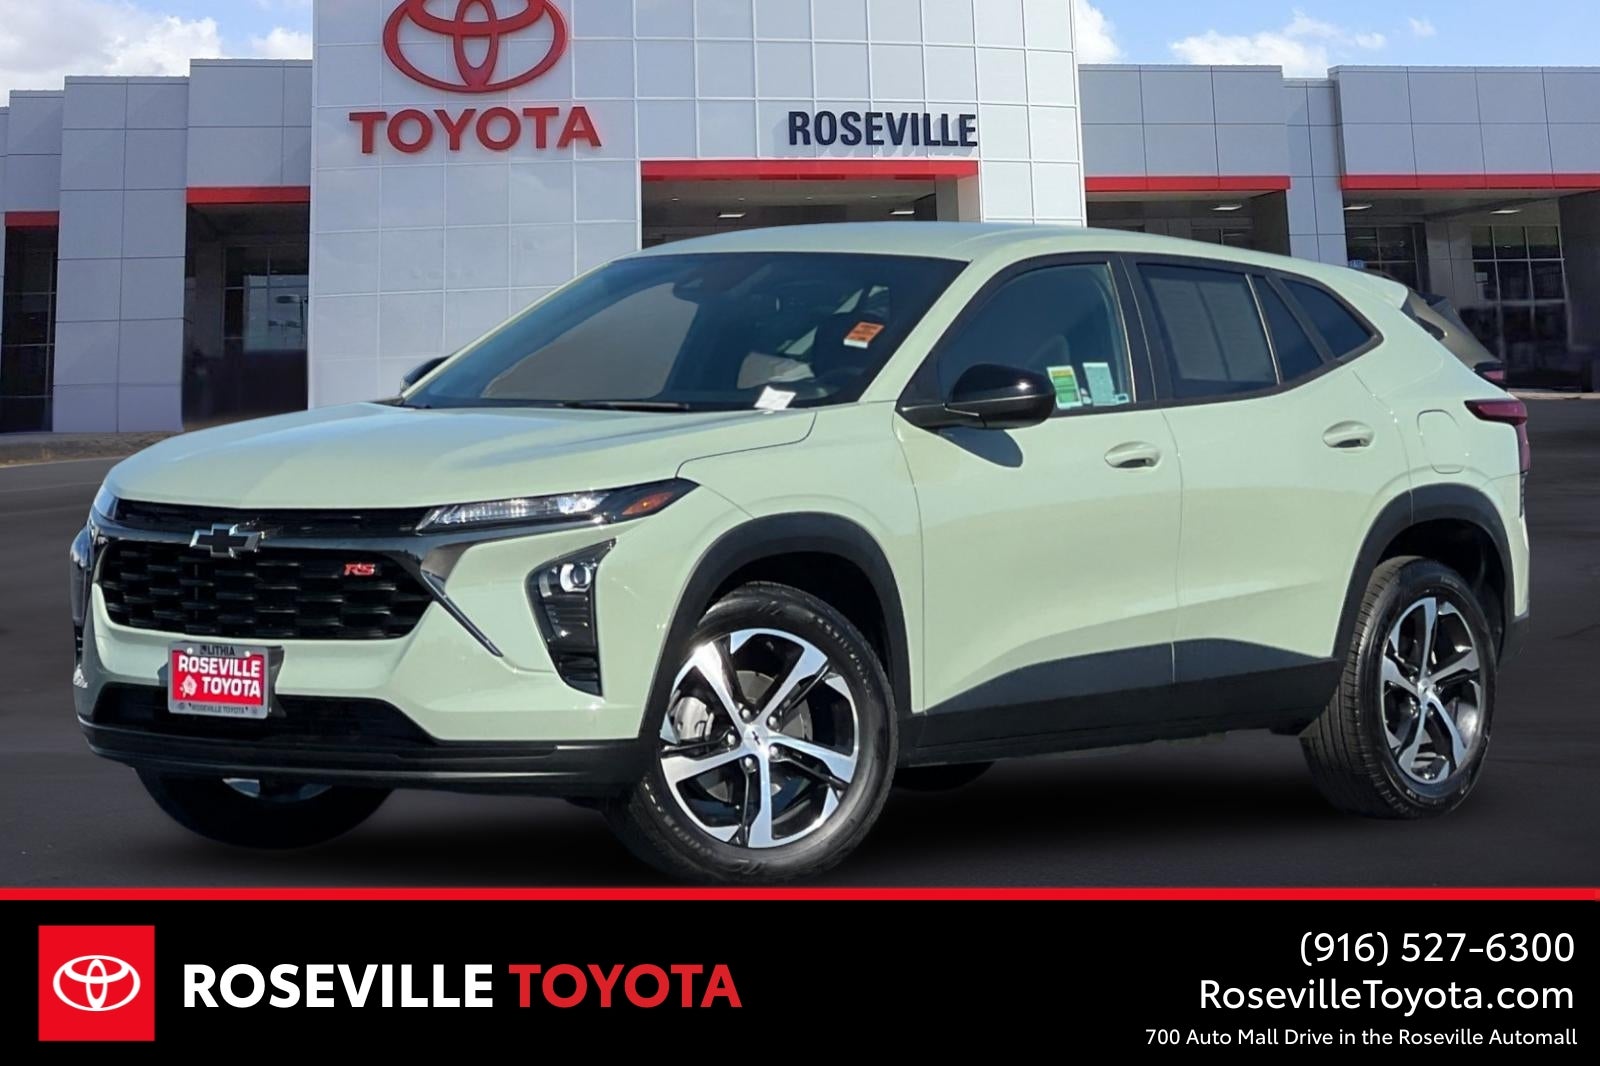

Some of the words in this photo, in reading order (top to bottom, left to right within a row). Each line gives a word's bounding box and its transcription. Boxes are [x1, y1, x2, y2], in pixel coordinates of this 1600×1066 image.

[349, 106, 602, 154] TOYOTA
[788, 110, 978, 147] ROSEVILLE
[344, 563, 375, 576] RS
[207, 645, 235, 657] LITHIA
[178, 655, 261, 678] ROSEVILLE
[202, 676, 261, 698] TOYOTA
